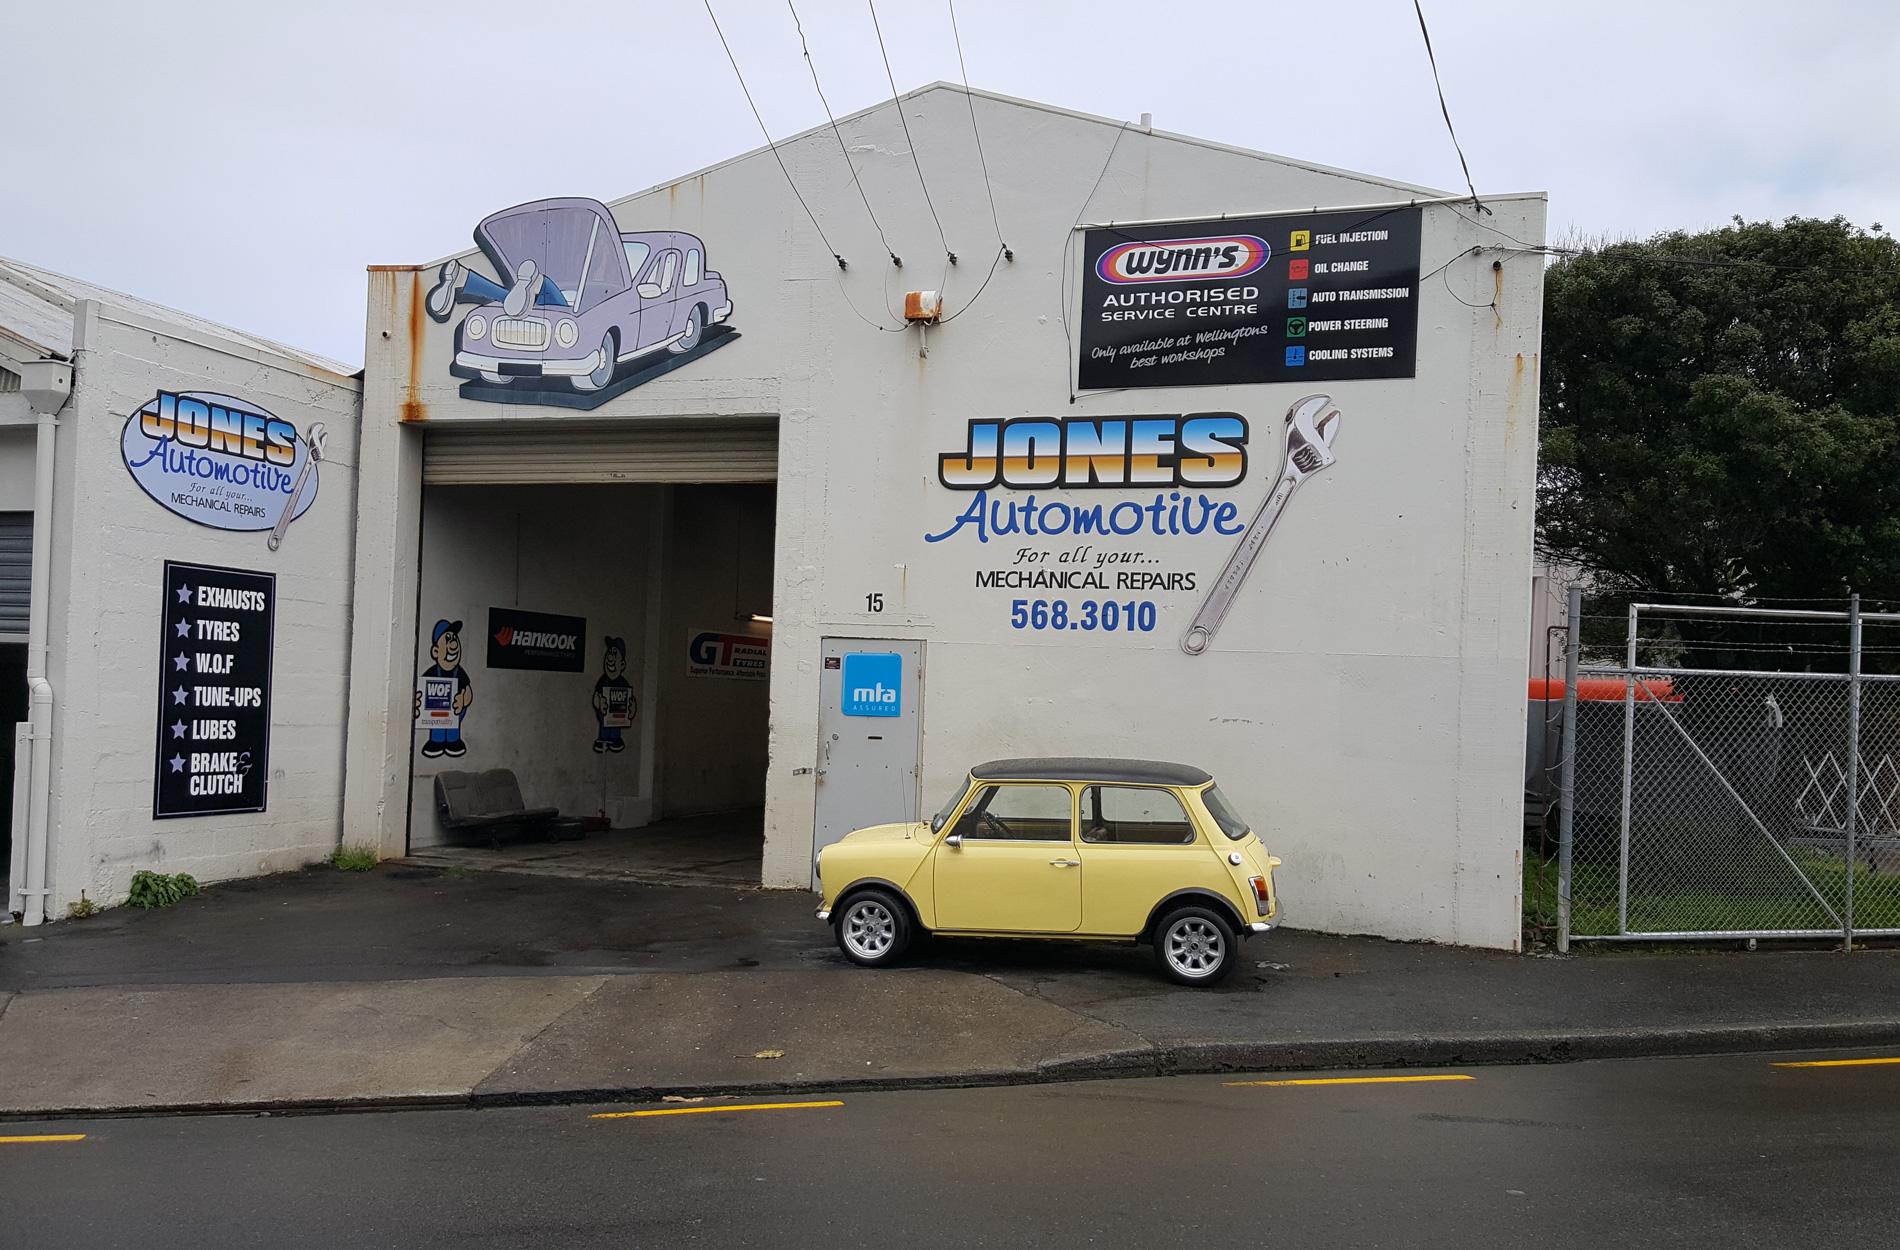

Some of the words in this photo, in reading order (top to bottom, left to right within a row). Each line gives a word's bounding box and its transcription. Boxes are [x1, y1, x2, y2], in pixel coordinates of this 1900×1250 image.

[1315, 233, 1338, 245] FUEL
[1339, 230, 1389, 244] INJECTION
[1314, 263, 1329, 274] OIL
[1331, 260, 1369, 273] CHANGE
[1103, 286, 1259, 308] AUTHORISED
[1312, 291, 1336, 303] AUTO
[1338, 287, 1409, 301] TRANSMISSION
[1101, 308, 1175, 322] SERVICE
[1186, 304, 1258, 317] CENTRE
[1308, 320, 1342, 332] POWER
[1343, 318, 1389, 330] STEERING
[1091, 346, 1116, 363] Only
[1119, 337, 1175, 354] available
[1176, 334, 1192, 347] at
[1195, 324, 1268, 346] Wellingtons
[1309, 349, 1348, 361] COOLING
[1350, 347, 1394, 359] SYSTEMS
[1130, 354, 1157, 369] best
[1161, 346, 1226, 364] workshops
[140, 389, 297, 468] JONES
[938, 411, 1249, 490] JONES
[129, 434, 296, 494] Automotive
[189, 482, 206, 493] For
[209, 485, 225, 496] all
[171, 492, 231, 512] MECHANICAL
[233, 503, 266, 518] REPAIRS
[924, 489, 1246, 544] Automotive
[1013, 546, 1050, 565] For
[1058, 545, 1093, 564] all
[1093, 549, 1160, 569] your...
[975, 570, 1110, 590] MECHANICAL
[1116, 571, 1196, 591] REPAIRS
[197, 585, 265, 612] EXHAUSTS
[866, 593, 884, 613] 15
[1011, 599, 1157, 631] 568.3010
[196, 619, 240, 642] TYRES
[690, 632, 768, 666] GT
[734, 647, 767, 656] RADIAL
[195, 653, 234, 674] W.O.F
[735, 659, 764, 668] TYRES
[193, 686, 262, 707] TUNE-UPS
[427, 683, 451, 697] WOF
[611, 690, 627, 701] WOF
[853, 682, 896, 703] mta
[192, 719, 236, 740] LUBES
[190, 752, 237, 774] BRAKE
[189, 774, 243, 796] CLUTCH
